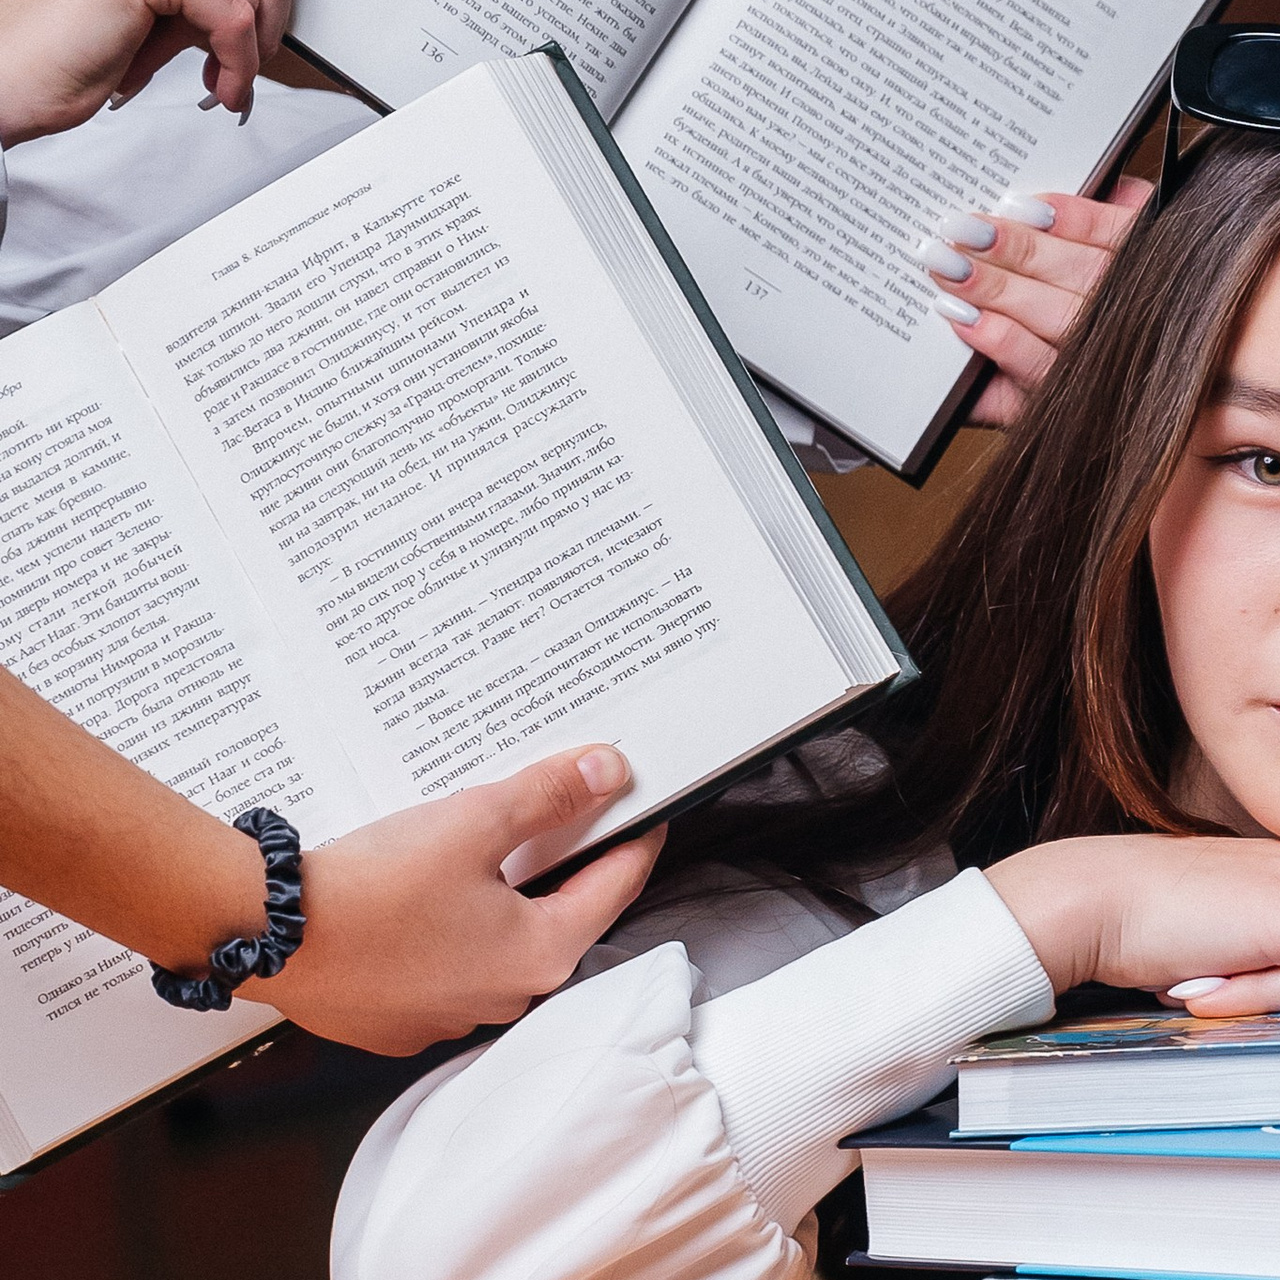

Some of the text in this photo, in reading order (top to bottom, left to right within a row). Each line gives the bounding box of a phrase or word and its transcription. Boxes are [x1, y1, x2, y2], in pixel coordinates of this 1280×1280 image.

[420, 40, 445, 63] 136
[210, 182, 372, 281] Глава 8. Калькуттские морозы
[164, 173, 462, 354] водителя джинн-клана Ифрит, в Калькутте тоже
[173, 190, 472, 370] имелся шпион. Звали его Упендра Даунмидхари.
[220, 303, 467, 452] Лас-Вегаса в Индию ближайшим рейсом.
[32, 449, 131, 505] меня в камине,
[34, 482, 106, 524] как бревно.
[27, 543, 183, 633] стали легкой добычей
[296, 556, 333, 583] вслух:
[42, 614, 170, 688] в корзину для белья.
[343, 628, 401, 665] под носа.
[172, 689, 262, 741] температурах
[381, 687, 449, 731] лако дыма.
